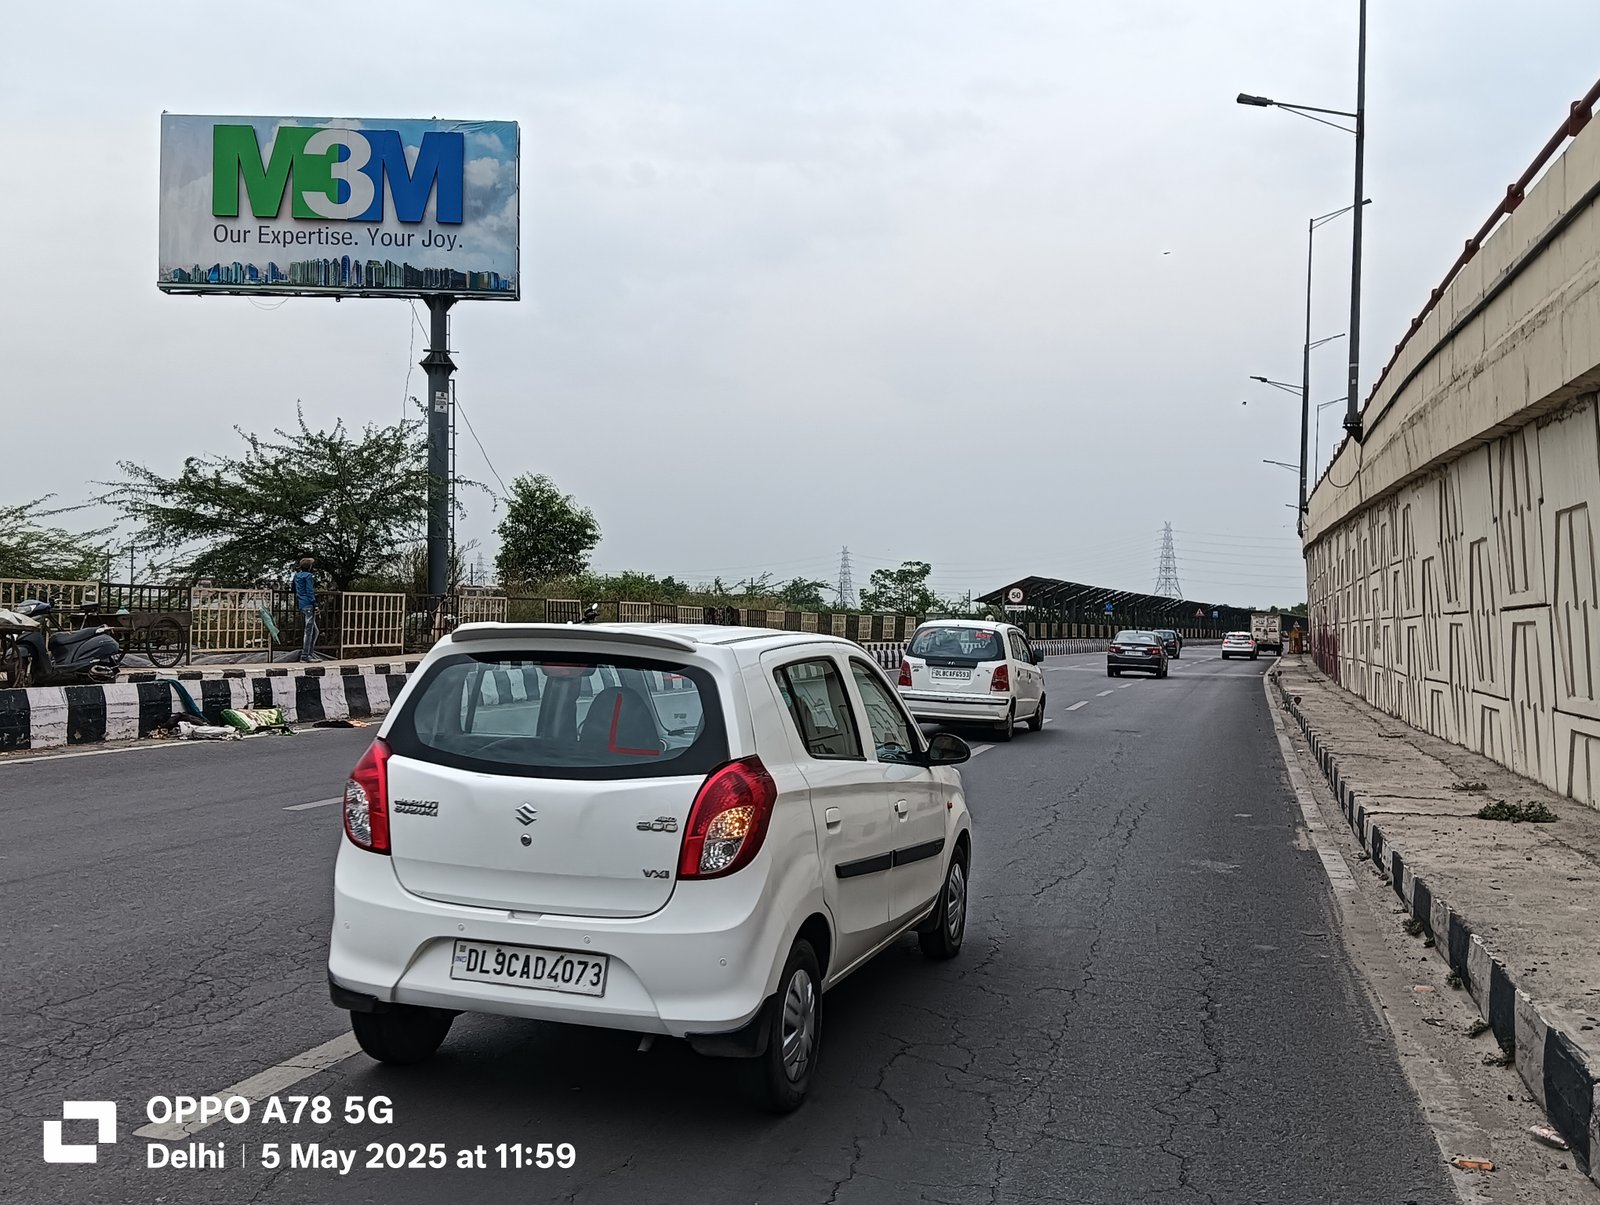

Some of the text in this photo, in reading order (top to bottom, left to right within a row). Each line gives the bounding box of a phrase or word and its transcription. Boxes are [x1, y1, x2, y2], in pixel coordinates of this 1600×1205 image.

[212, 124, 464, 224] M3M
[213, 224, 463, 251] Our Expertise. Your Joy.
[466, 948, 603, 987] DL9CAD4073
